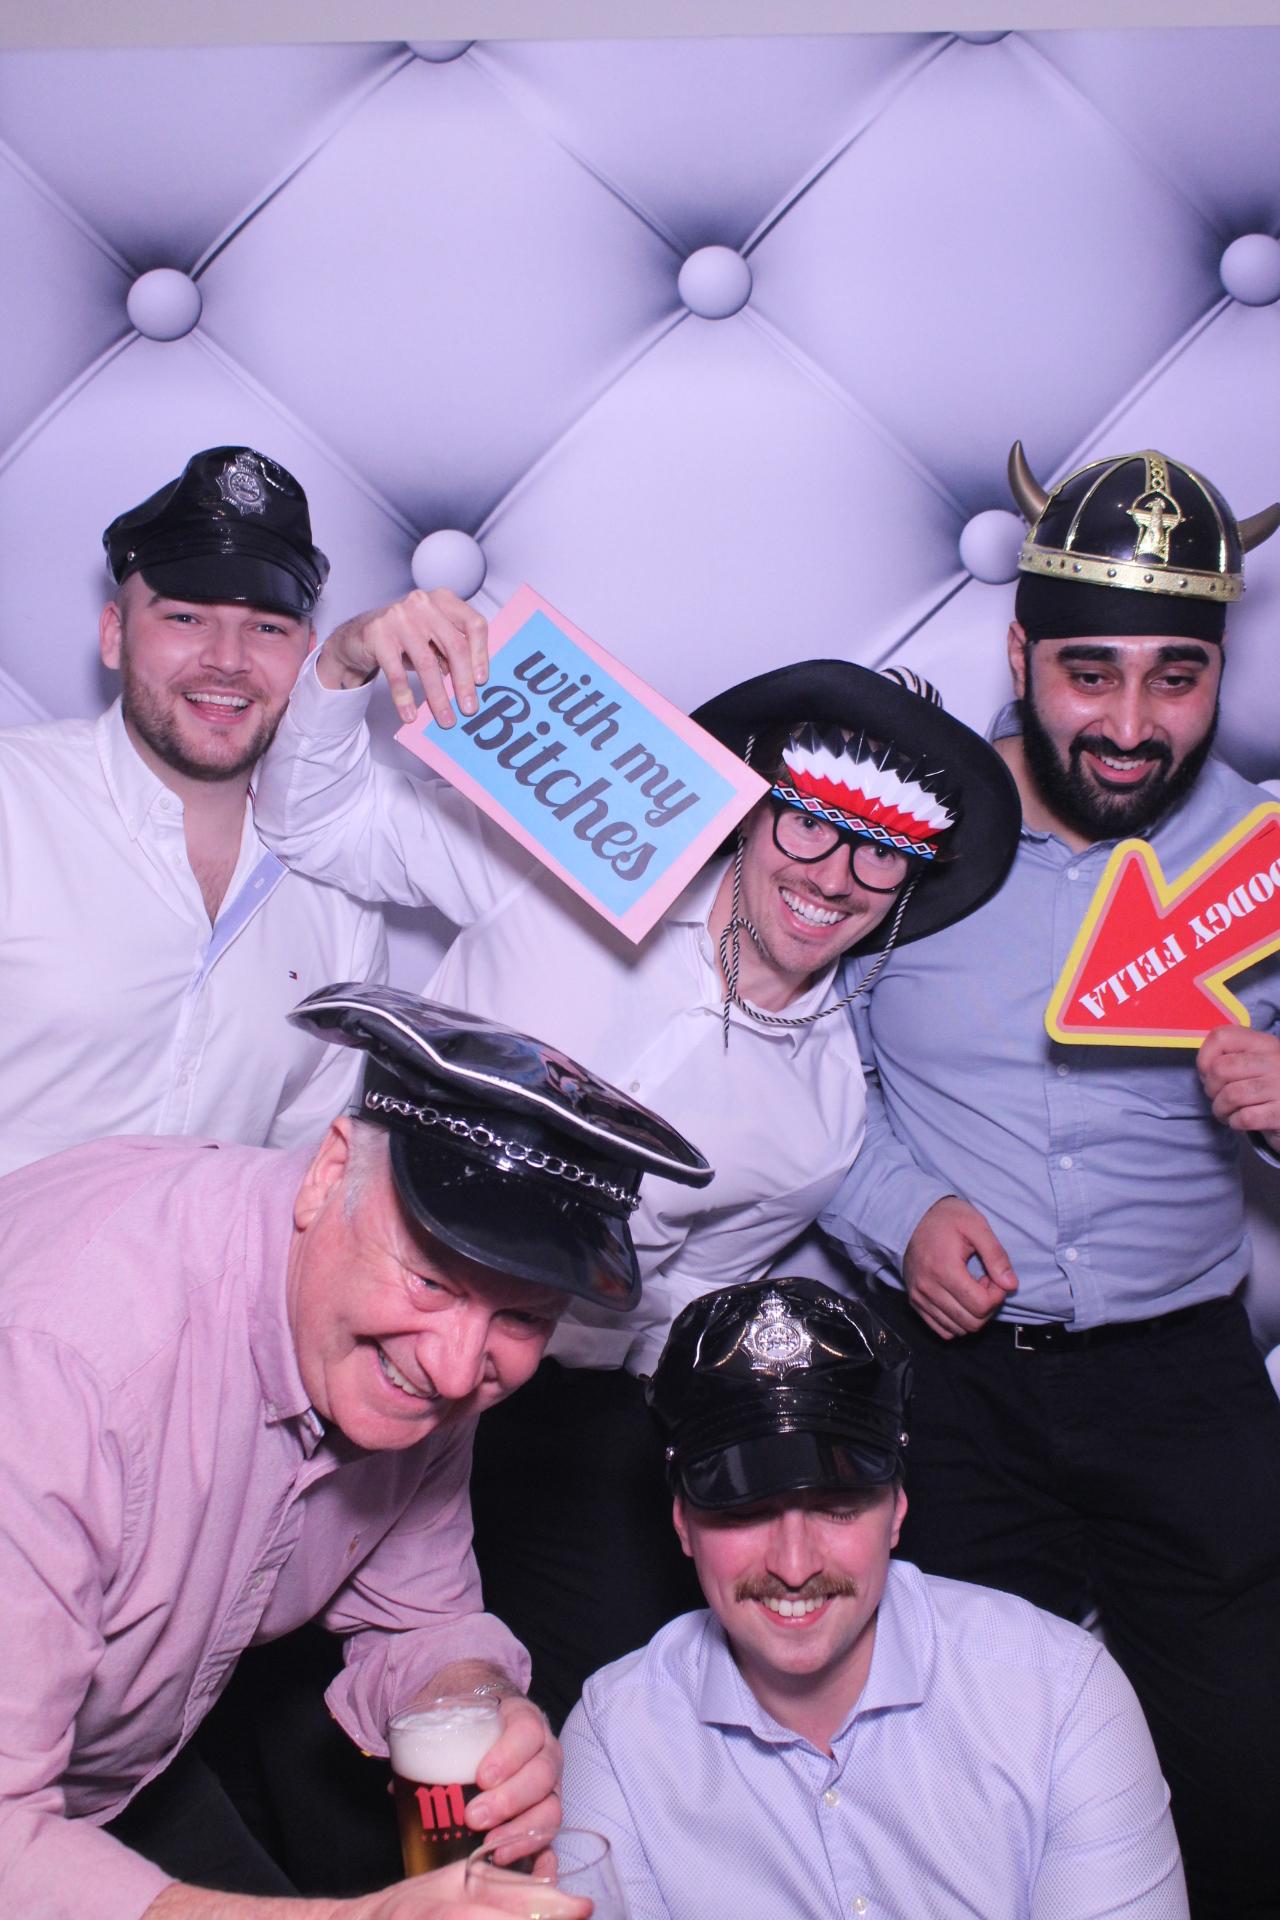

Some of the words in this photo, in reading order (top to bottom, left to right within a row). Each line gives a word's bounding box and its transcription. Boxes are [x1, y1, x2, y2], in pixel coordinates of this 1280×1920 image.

[460, 684, 658, 882] Bitches
[513, 650, 622, 751] with
[609, 742, 701, 829] my
[1078, 933, 1187, 1019] FELLA
